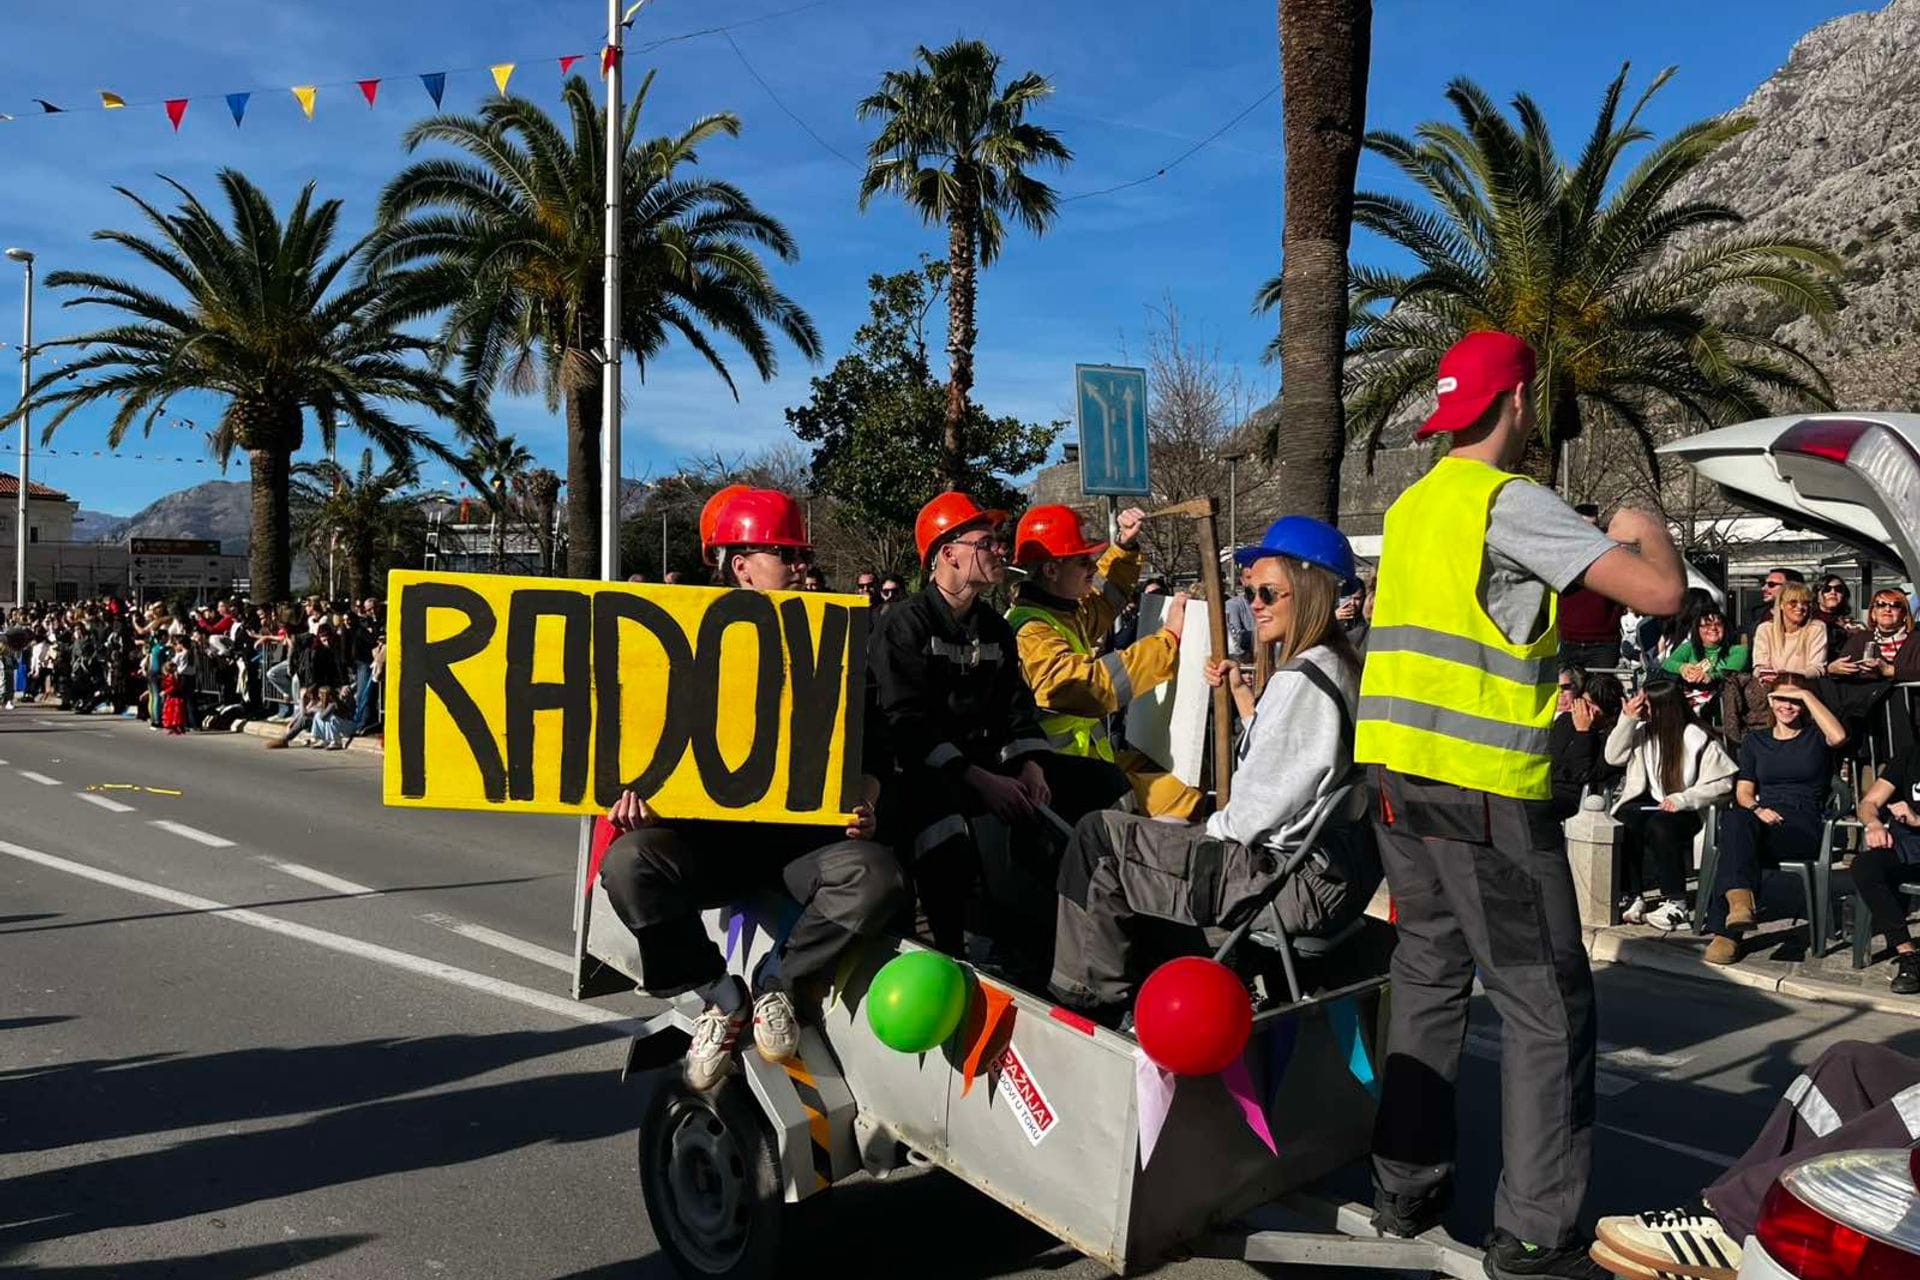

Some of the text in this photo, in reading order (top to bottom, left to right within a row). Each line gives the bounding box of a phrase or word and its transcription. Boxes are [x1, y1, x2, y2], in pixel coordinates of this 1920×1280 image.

[399, 582, 868, 812] RADOVI
[1015, 1101, 1023, 1110] U
[1021, 1111, 1041, 1140] TOKU
